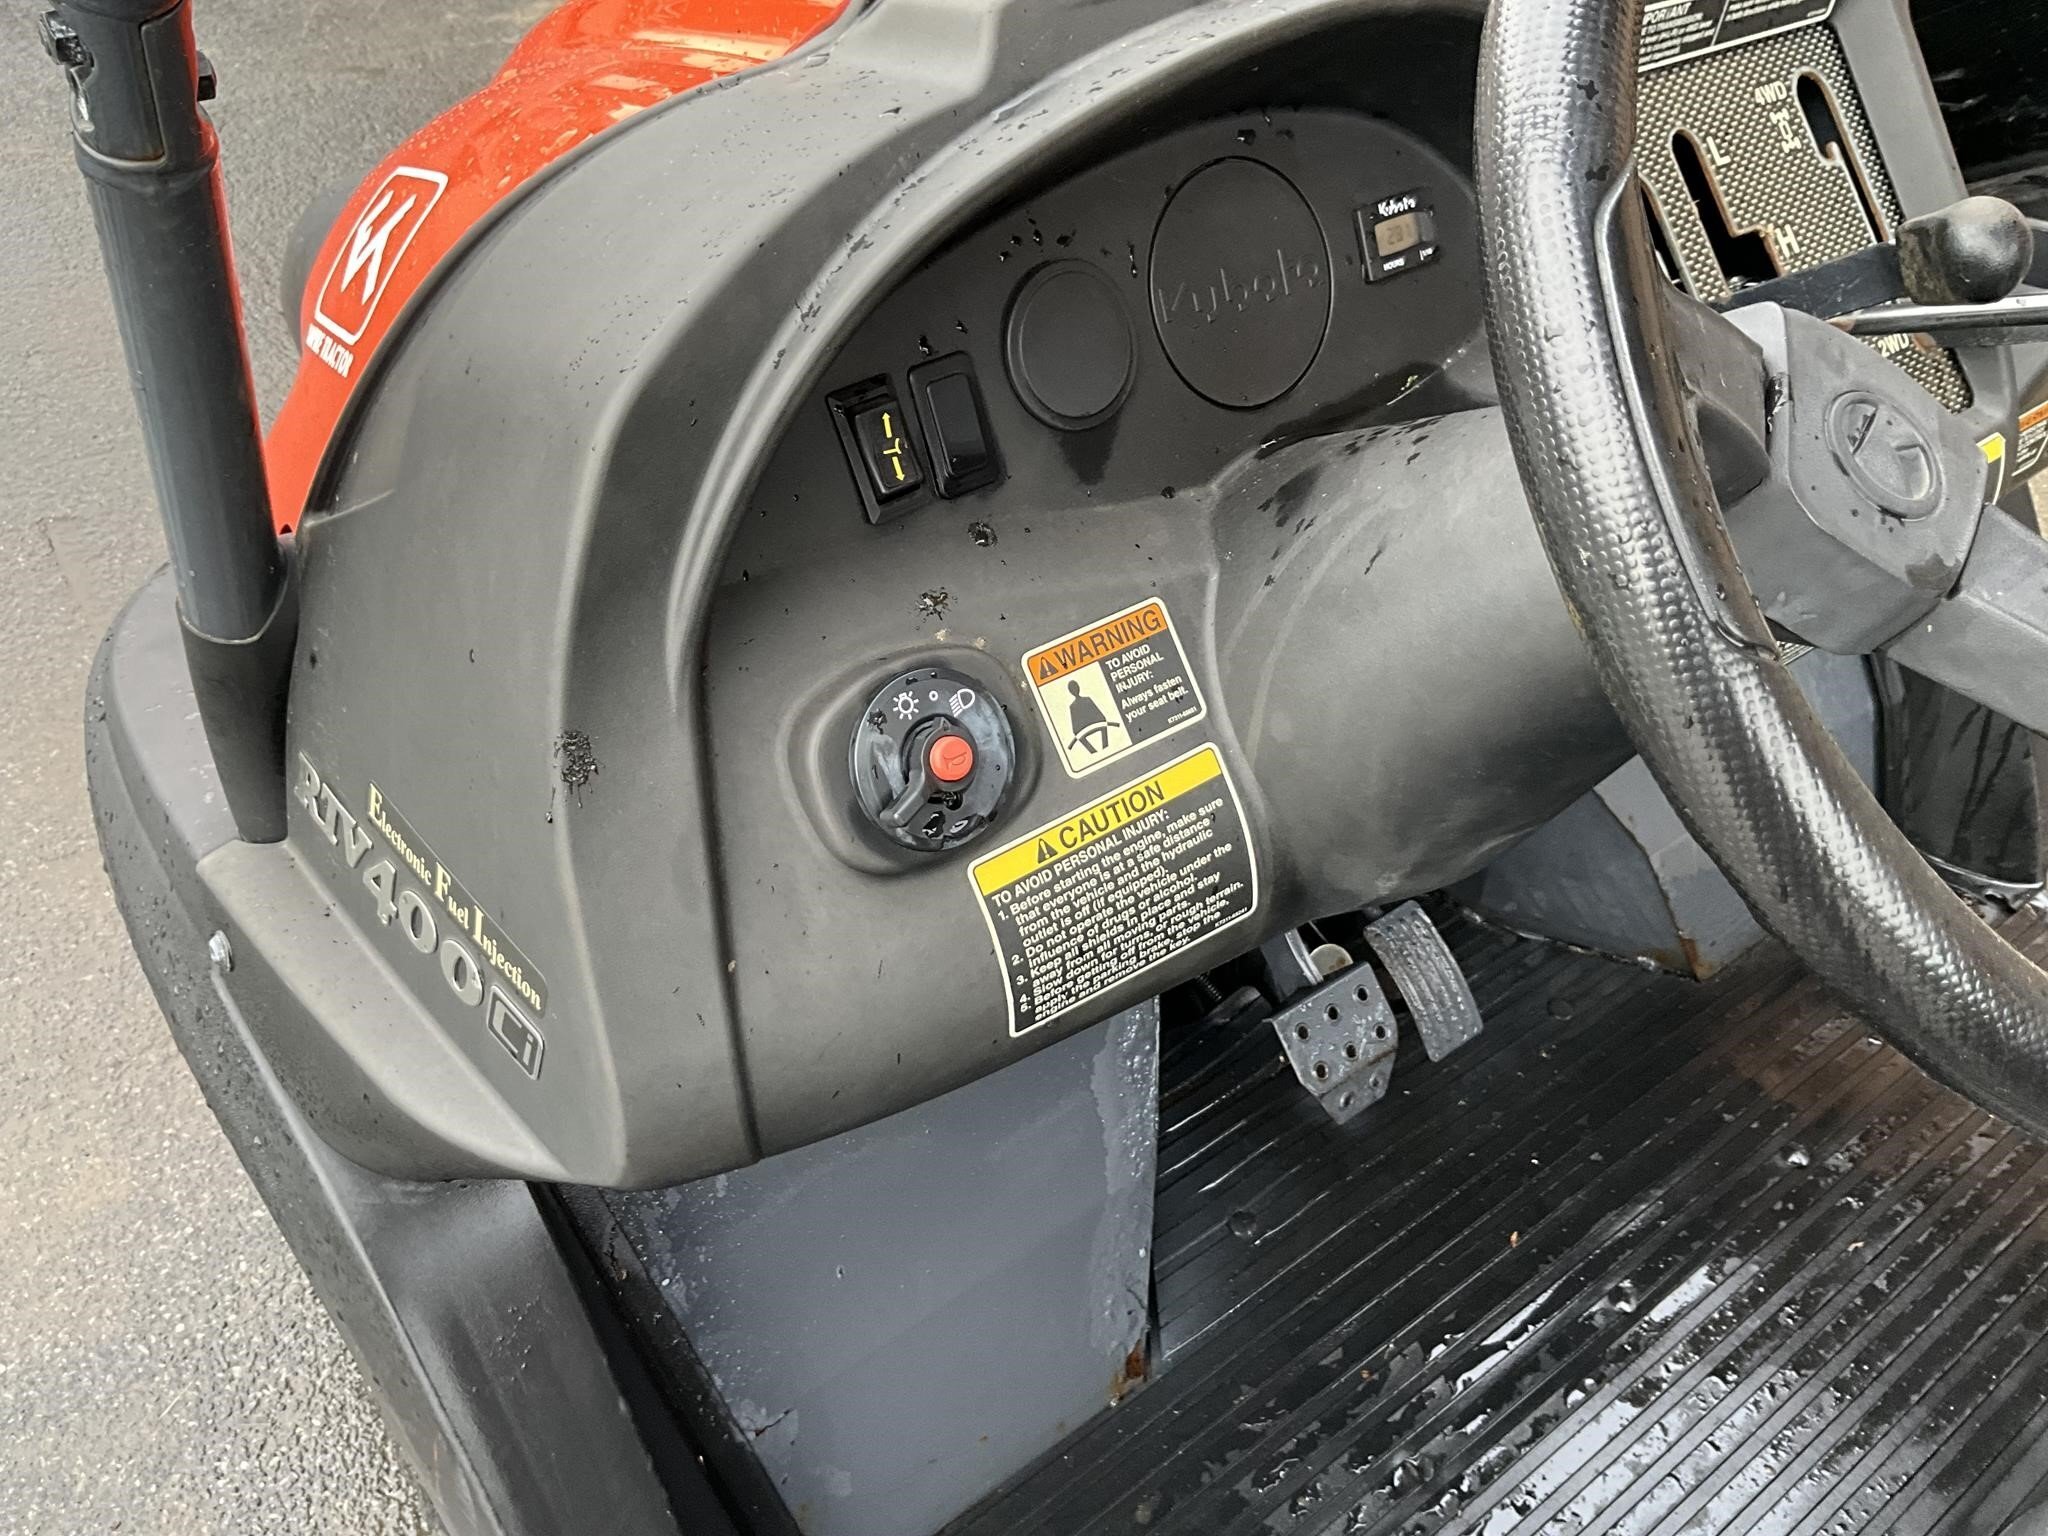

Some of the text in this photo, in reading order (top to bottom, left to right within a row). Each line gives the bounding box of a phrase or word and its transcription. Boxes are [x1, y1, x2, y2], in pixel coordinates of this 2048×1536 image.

[1754, 81, 1787, 106] 4WD
[1706, 136, 1730, 167] L
[1776, 225, 1800, 258] H
[1158, 247, 1325, 324] Kubota
[1877, 332, 1911, 358] 2WD
[1053, 610, 1162, 670] WARNING
[1105, 644, 1150, 670] TO AVOID
[1110, 652, 1164, 682] PERSONAL
[1115, 670, 1154, 694] INJURY:
[1122, 676, 1182, 710] Always fasten
[1125, 686, 1189, 723] your seat belt.
[1059, 780, 1165, 849] CAUTION
[368, 782, 542, 1010] Electronic Fuel Injection
[991, 808, 1170, 907] TO AVOID PERSONAL INJURY:
[998, 798, 1223, 921] 1. Before starting the engine, make sure
[1015, 818, 1210, 926] that everyone is at a safe distance
[1018, 829, 1213, 937] from the vehicle and the hydraulic
[1011, 843, 1232, 966] 2. Do not operate the vehicle under the
[1016, 872, 1220, 986] 3. Keep all shields in place and stay
[1019, 994, 1031, 1003] 4.
[1033, 972, 1063, 996] Slow
[1066, 954, 1098, 980] down
[1099, 942, 1118, 961] for
[1154, 920, 1168, 932] or
[1168, 902, 1203, 928] rough
[1205, 882, 1244, 905] terrain.
[1022, 865, 1169, 948] outlet is off (if equipped).
[1028, 872, 1198, 968] influence of drugs or alcohol.
[1032, 898, 1191, 990] away from all moving parts.
[1020, 998, 1032, 1013] 5.
[1034, 976, 1073, 1006] Before
[1076, 952, 1118, 987] getting
[1120, 945, 1136, 960] off
[1138, 928, 1164, 950] from
[1166, 918, 1185, 936] the
[1035, 930, 1192, 1021] engine and remove the key.
[1071, 976, 1090, 994] the
[1092, 952, 1136, 985] parking
[1176, 922, 1200, 939] stop
[1202, 911, 1220, 925] the
